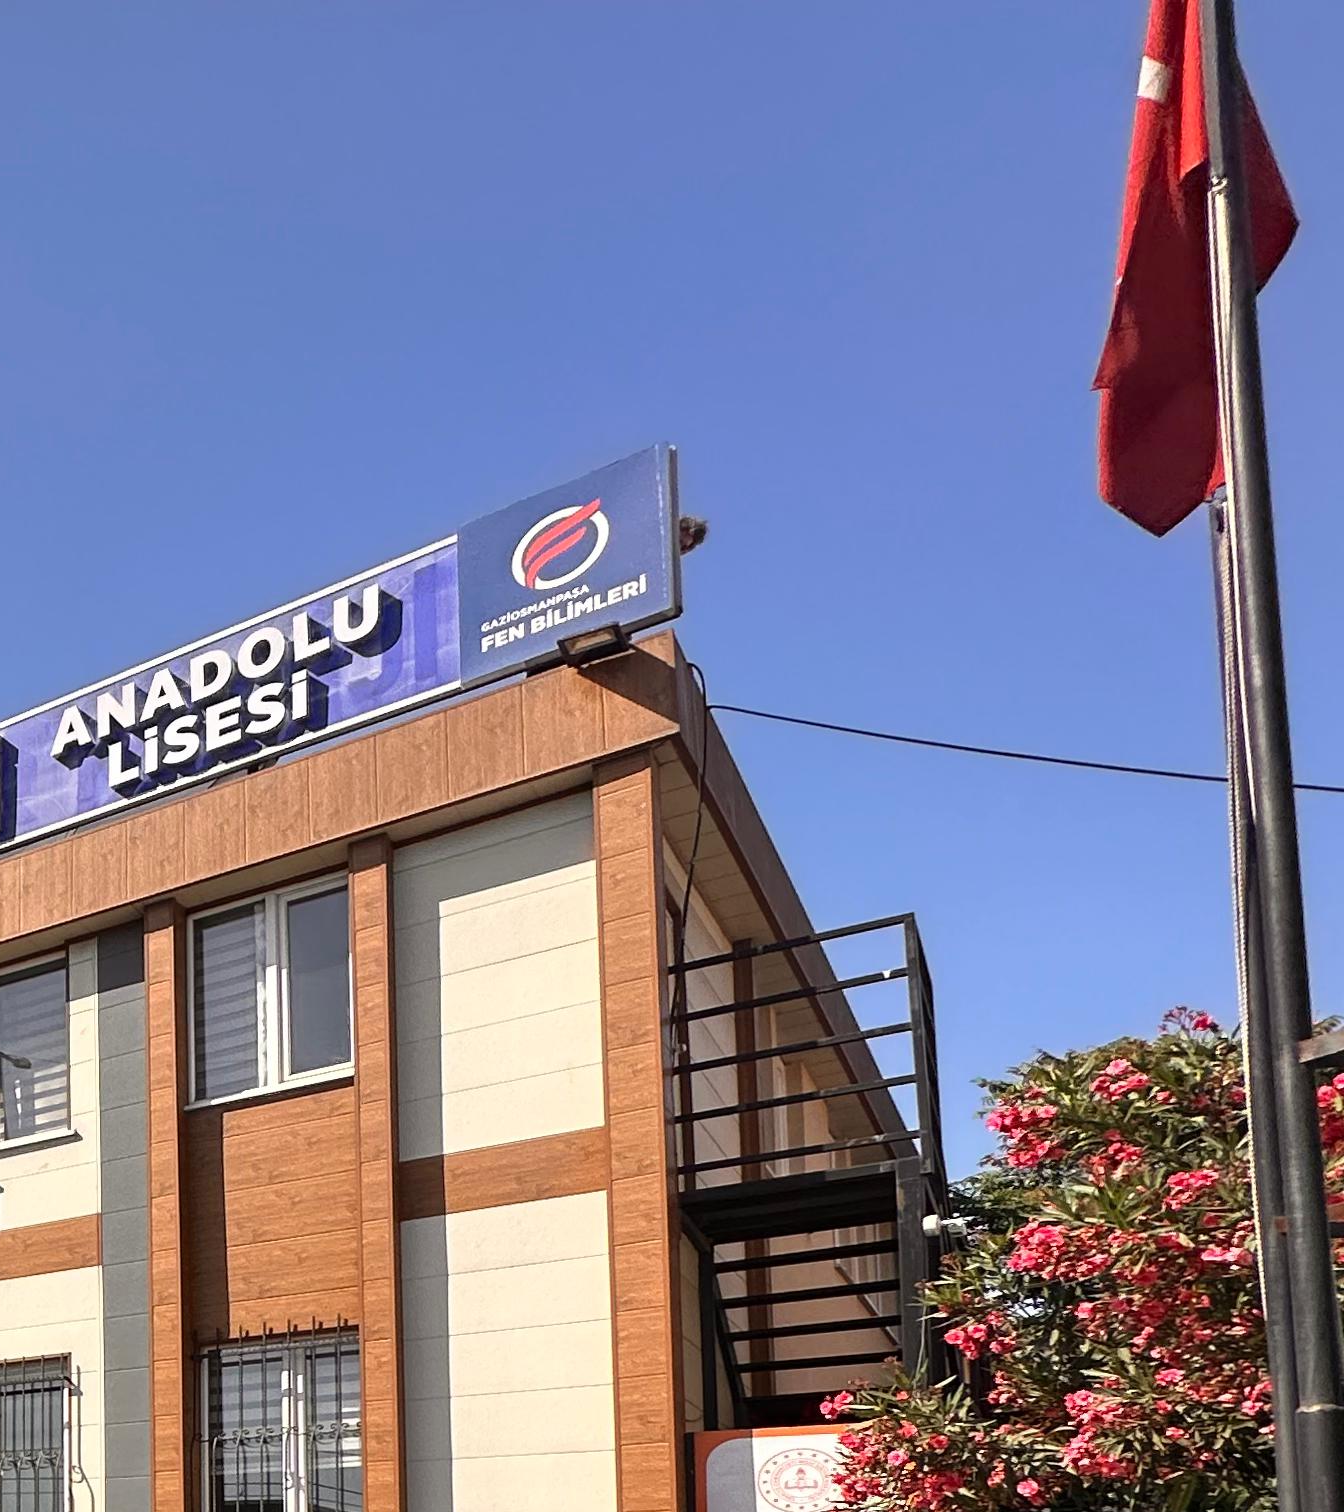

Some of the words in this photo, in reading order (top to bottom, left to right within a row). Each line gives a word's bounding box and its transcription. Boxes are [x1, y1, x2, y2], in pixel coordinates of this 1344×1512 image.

[480, 584, 590, 633] GAZİOSMANPAŞA
[480, 622, 527, 653] FEN
[529, 573, 648, 636] BİLİMLERİ
[50, 582, 384, 757] ANADOLU
[108, 669, 310, 790] LİSESİ
